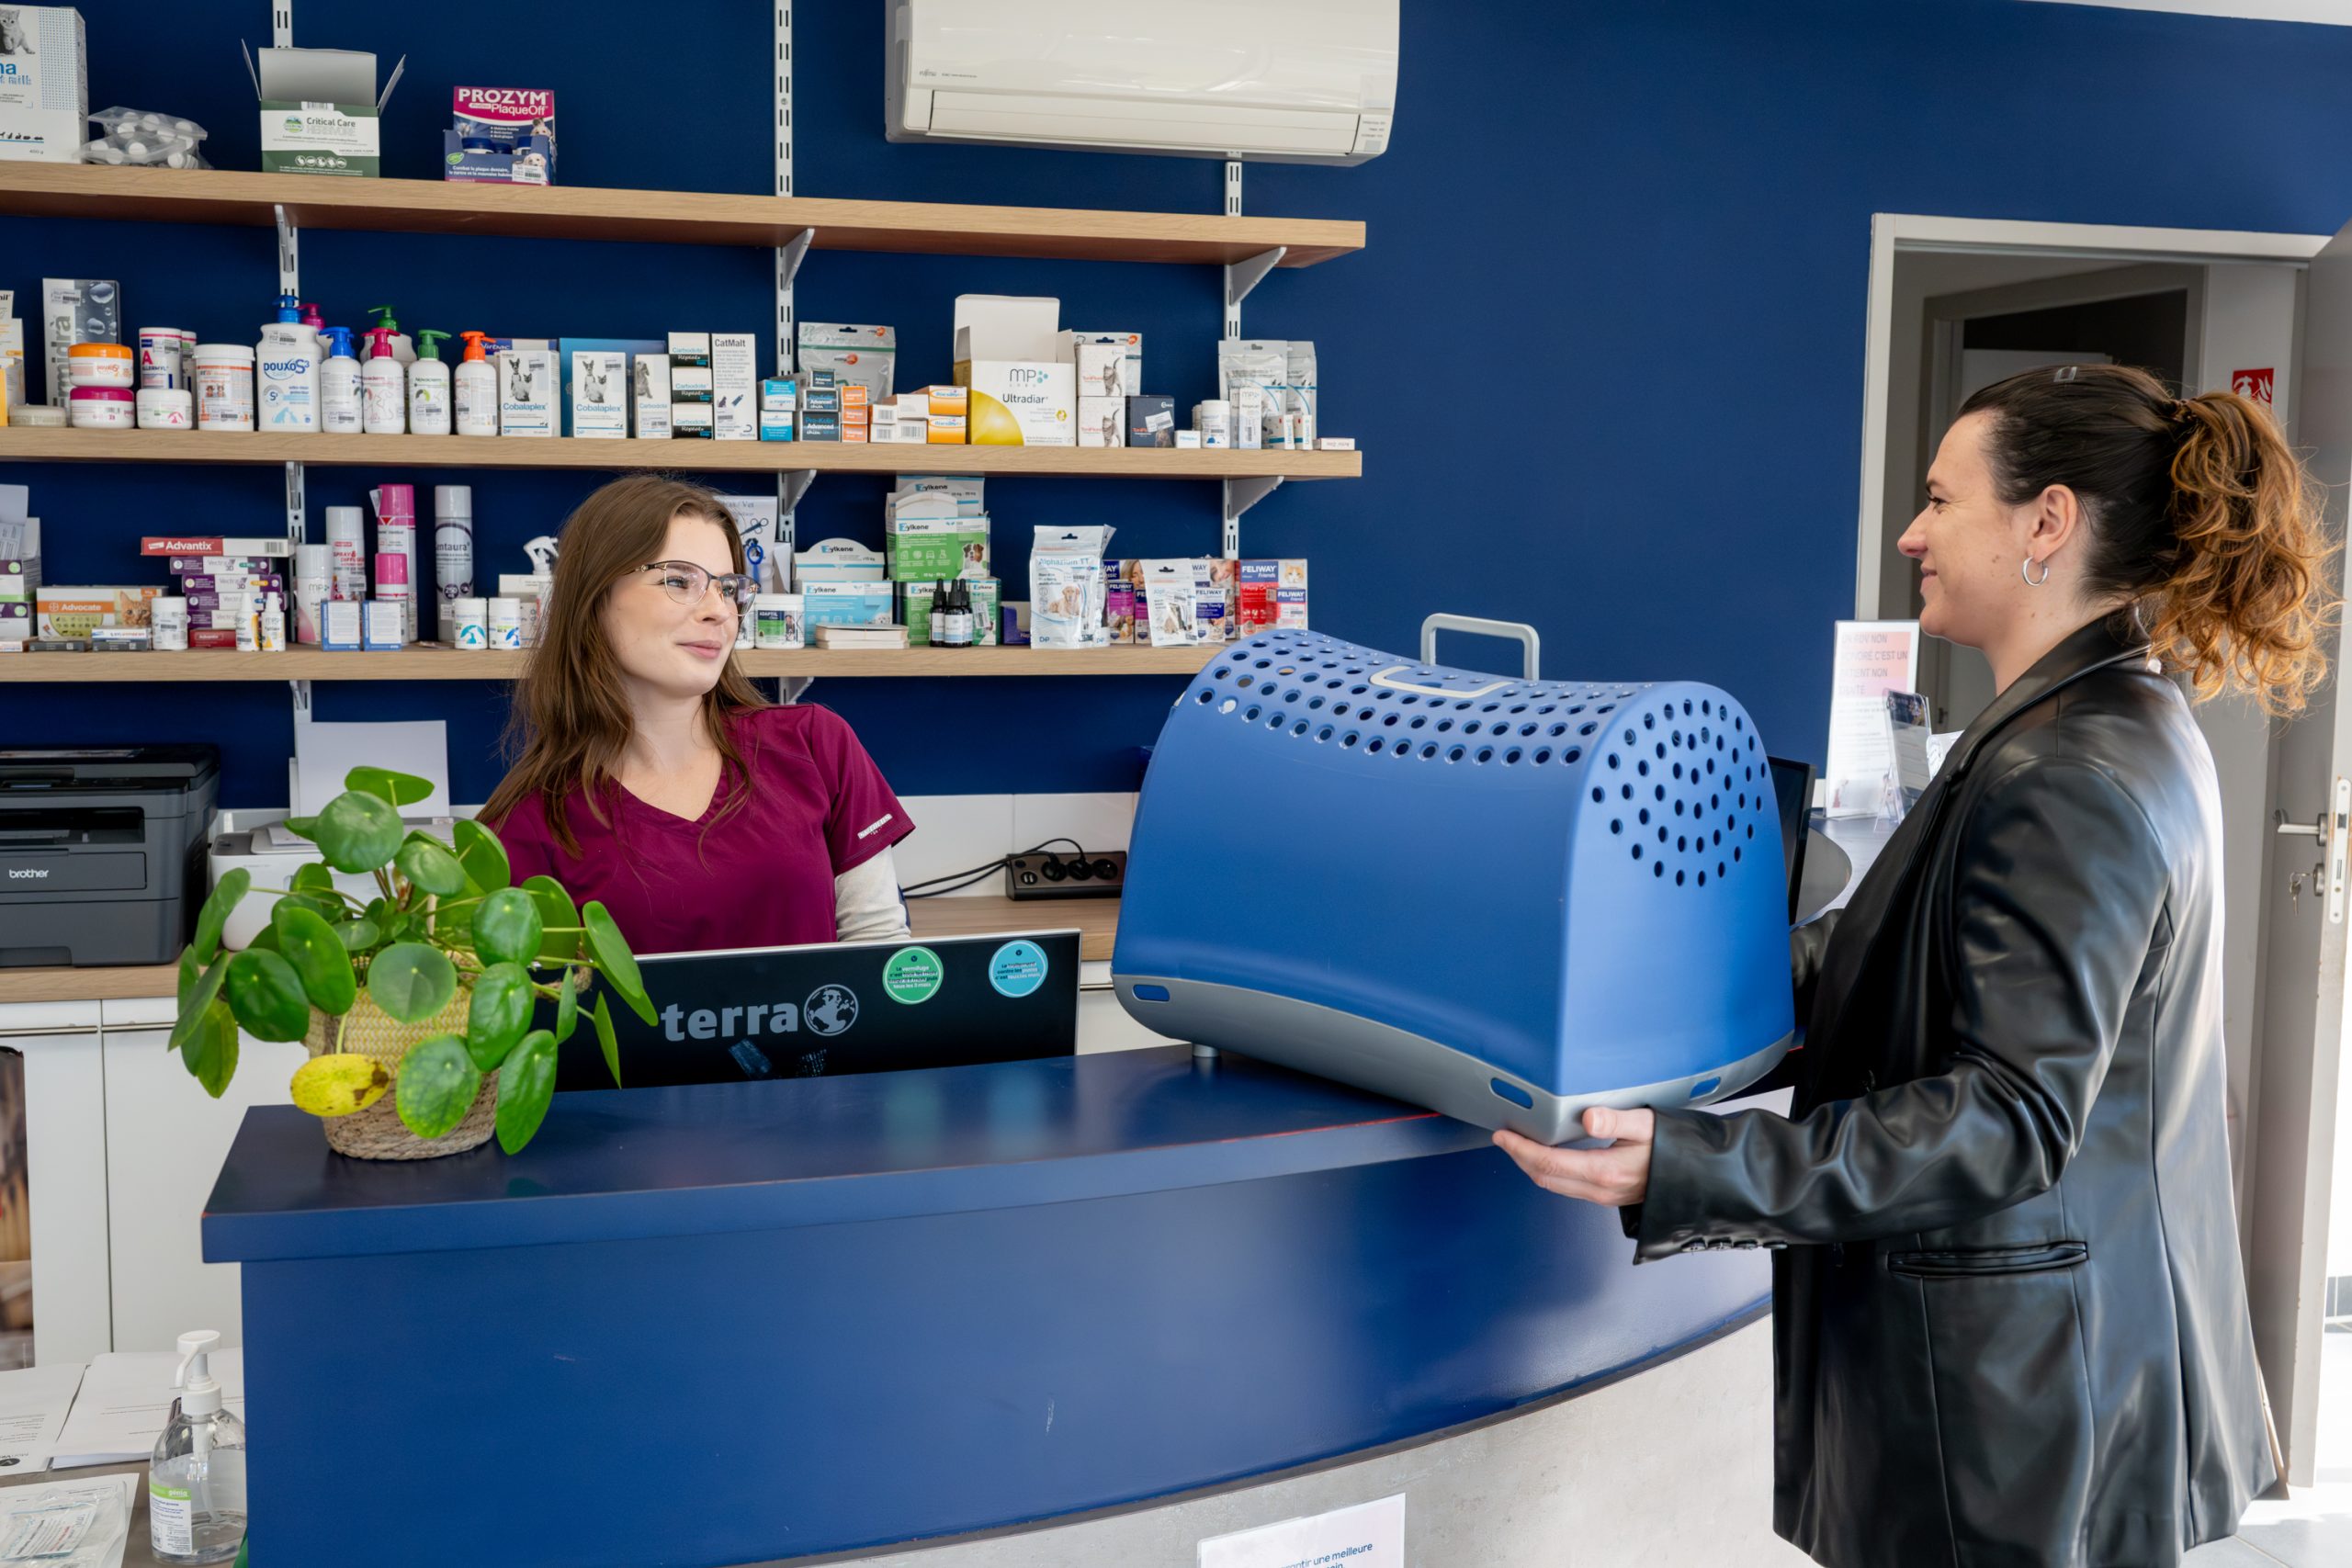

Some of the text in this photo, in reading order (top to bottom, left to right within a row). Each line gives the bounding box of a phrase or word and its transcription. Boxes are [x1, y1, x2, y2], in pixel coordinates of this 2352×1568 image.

[458, 88, 547, 106] PROZYM
[491, 103, 546, 116] PlaqueOff
[306, 117, 356, 128] Critical Care
[715, 339, 746, 348] CatMalt
[263, 362, 296, 372] DOUXO
[1002, 393, 1045, 403] Ultradiar
[503, 402, 547, 412] Cobalaplex
[576, 404, 622, 412] Cobalaplex
[165, 541, 212, 551] Advantix
[1241, 565, 1276, 573] FELIWAY
[61, 603, 102, 611] Advocate
[1871, 633, 1888, 643] NON
[1875, 650, 1895, 660] C'EST
[1896, 650, 1908, 660] UN
[1871, 668, 1888, 678] NON
[9, 868, 49, 879] brother
[661, 1002, 798, 1042] terra
[1313, 1554, 1330, 1566] une
[1331, 1543, 1374, 1561] meilleure
